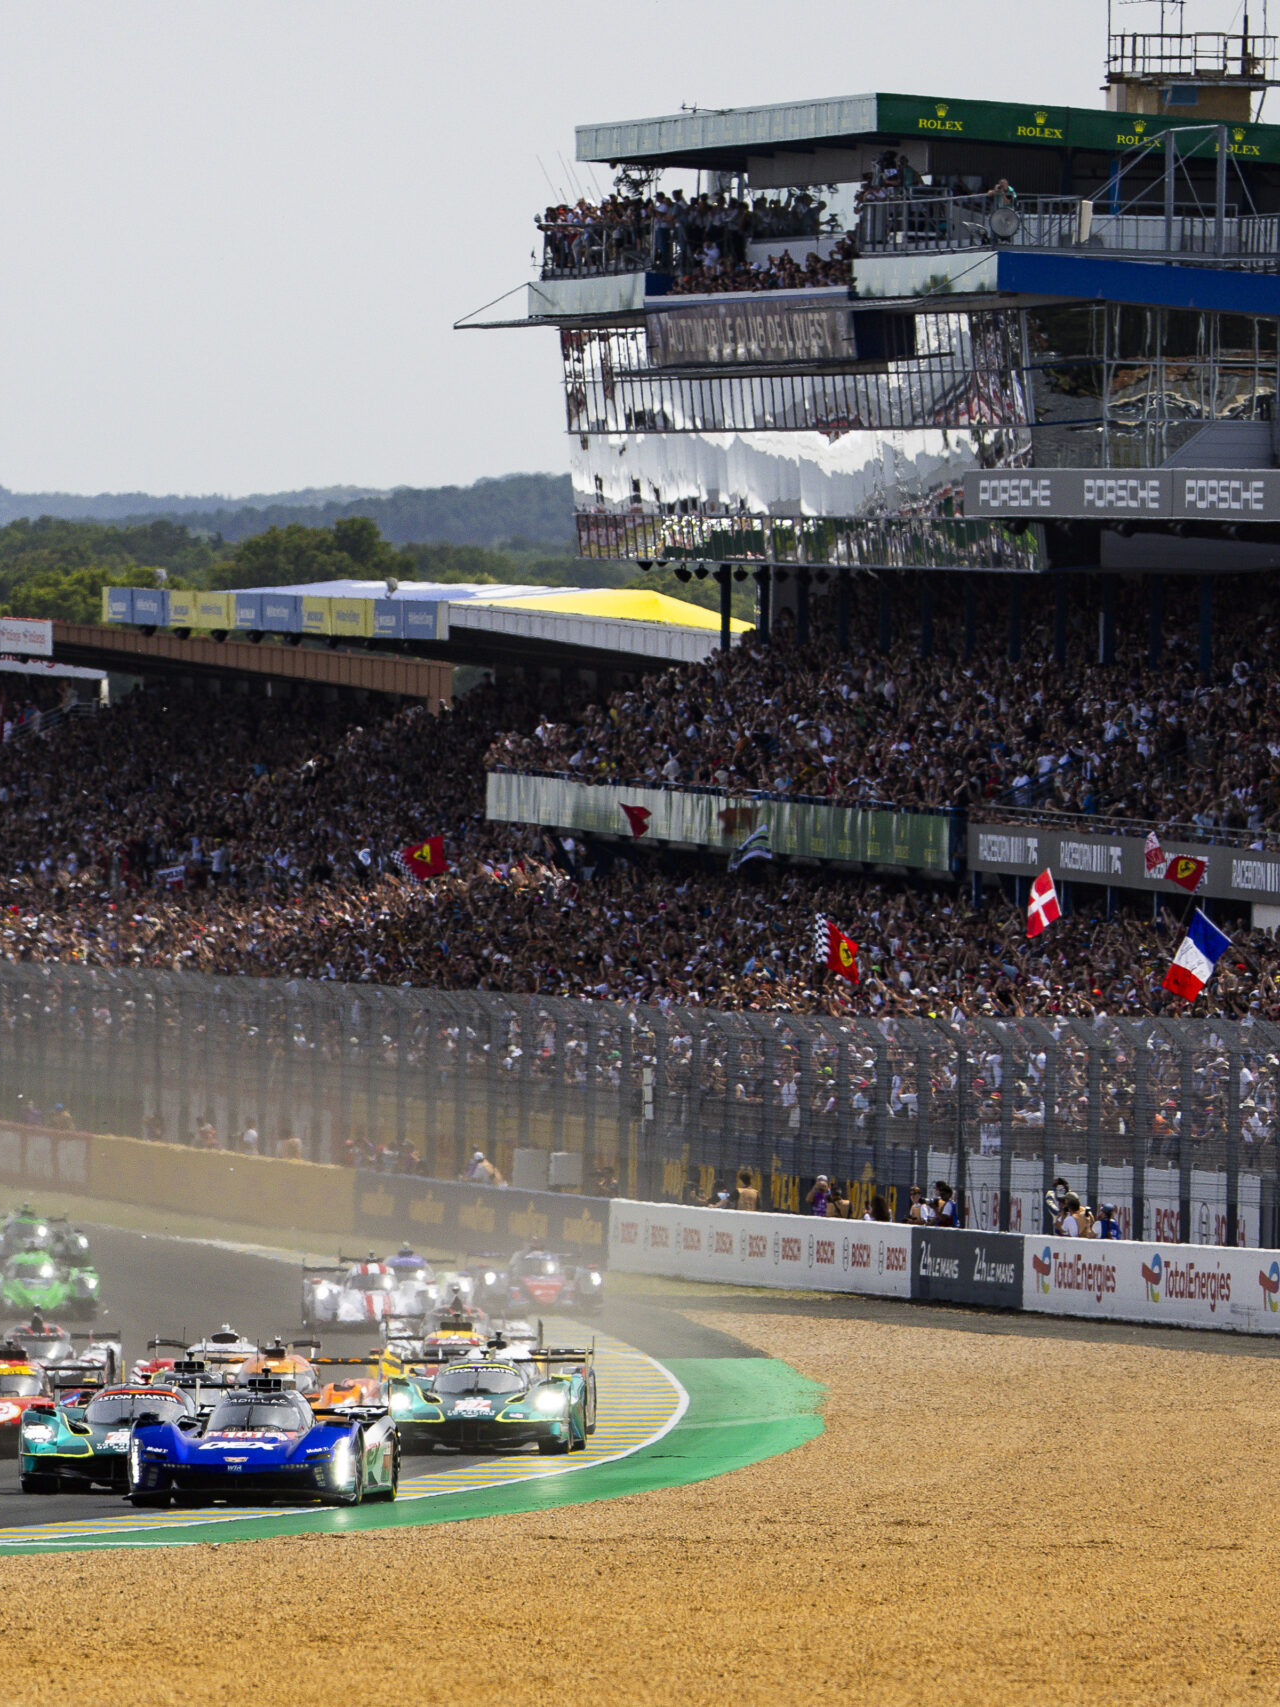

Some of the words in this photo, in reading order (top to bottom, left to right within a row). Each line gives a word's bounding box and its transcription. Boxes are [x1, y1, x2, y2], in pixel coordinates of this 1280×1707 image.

[918, 118, 963, 131] ROLEX
[1017, 126, 1063, 139] ROLEX
[979, 479, 1051, 507] PORSCHE
[1084, 479, 1159, 509] PORSCHE
[1185, 480, 1264, 510] PORSCHE
[816, 1240, 835, 1264] BOSCH
[851, 1243, 871, 1268] BOSCH
[886, 1247, 907, 1271] BOSCH
[940, 1258, 959, 1279] MANS
[996, 1263, 1015, 1284] MANS
[1053, 1252, 1117, 1303] TotalEnergies
[1164, 1260, 1232, 1313] TotalEnergies
[135, 1393, 177, 1402] MARTIN
